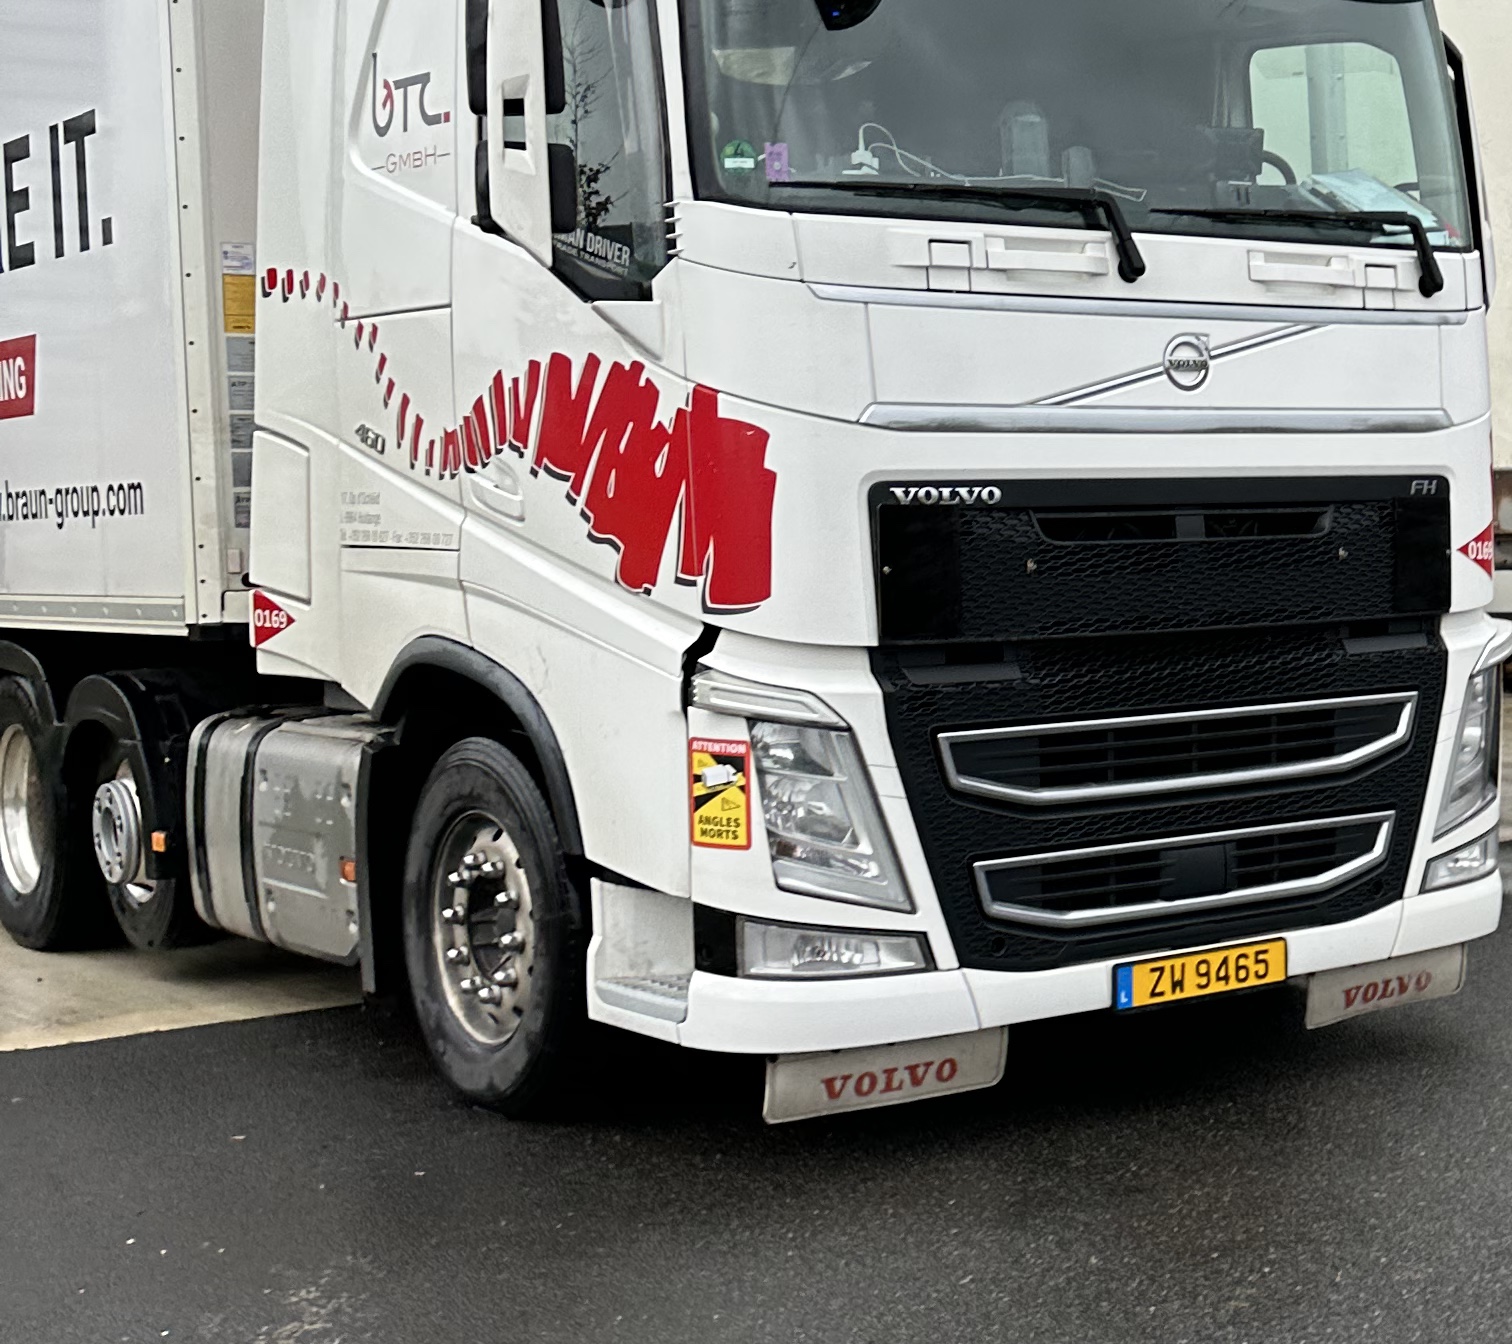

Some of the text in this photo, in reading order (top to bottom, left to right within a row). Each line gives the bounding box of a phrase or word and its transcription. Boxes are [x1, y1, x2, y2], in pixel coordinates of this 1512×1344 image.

[0, 109, 113, 274] E IT.
[586, 232, 630, 266] DRIVER
[1167, 359, 1208, 370] VOLVO
[355, 423, 385, 455] 460
[889, 486, 1002, 505] VOLVO
[1410, 479, 1437, 495] FH
[0, 479, 144, 529] .braun-group.com
[254, 609, 288, 628] 0169
[692, 740, 746, 754] ATTENTION
[698, 815, 740, 827] ANGLES
[700, 827, 739, 840] MORTS
[1149, 949, 1270, 999] ZW 9465
[1120, 990, 1129, 1003] L
[1342, 970, 1432, 1009] VOLVO
[821, 1057, 958, 1100] VOLVO
